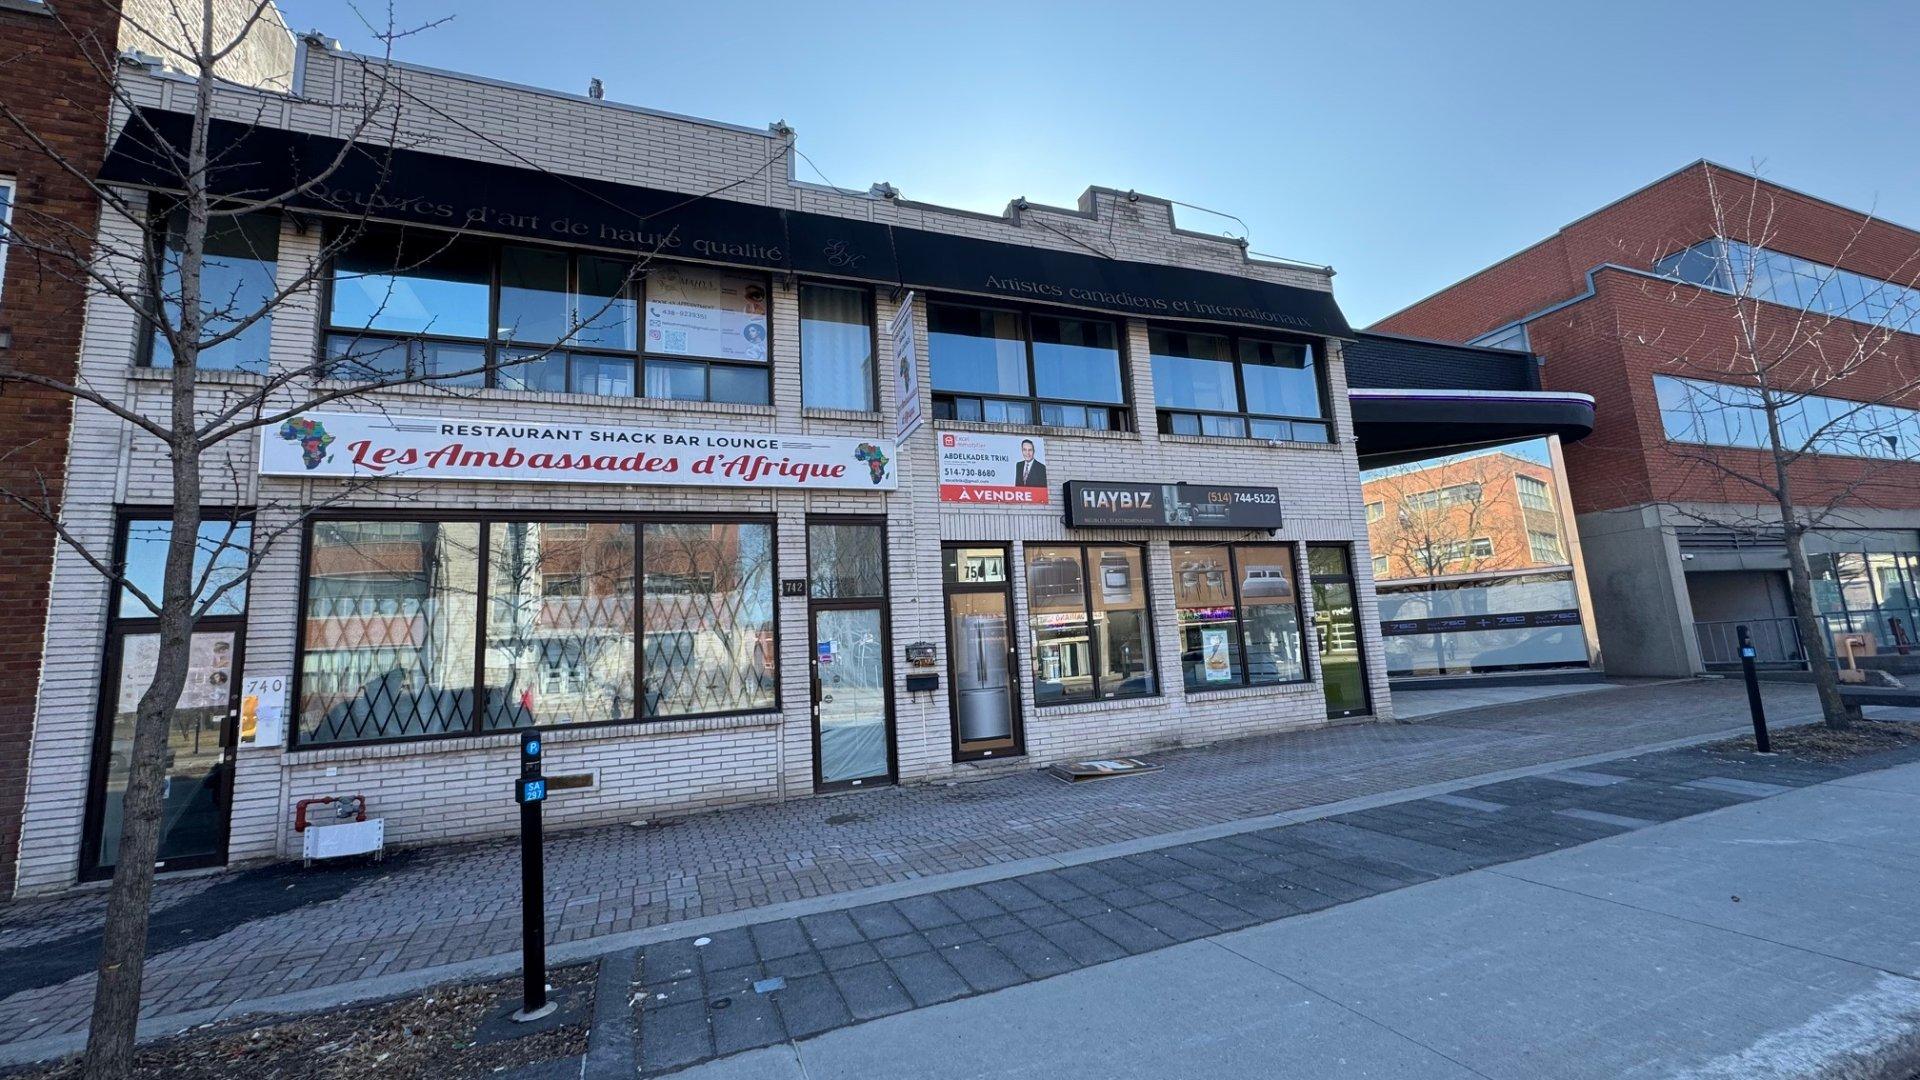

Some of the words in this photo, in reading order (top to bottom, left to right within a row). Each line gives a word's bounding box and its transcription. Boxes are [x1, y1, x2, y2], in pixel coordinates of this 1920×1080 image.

[465, 205, 540, 230] d'art
[550, 217, 590, 236] de
[693, 238, 784, 262] qualité
[984, 275, 1063, 297] Artistes
[1069, 287, 1167, 311] canadiens
[1172, 300, 1191, 313] et
[1194, 300, 1312, 328] internationaux
[441, 424, 583, 441] RESTAURANT
[589, 431, 657, 445] SHACK
[663, 434, 700, 446] BAR
[707, 436, 779, 450] LOUNGE
[347, 440, 418, 472] Les
[424, 443, 679, 473] Ambassades
[691, 453, 846, 482] d'Afrique
[944, 452, 989, 462] ABDELKADER
[991, 455, 1009, 463] TRIKI
[944, 467, 996, 478] 514-730-8680
[959, 487, 971, 500] À
[974, 490, 1033, 502] VENDRE
[1083, 490, 1153, 513] HAYBIZ
[1207, 491, 1232, 505] (514)
[1234, 492, 1276, 505] 744-5122
[786, 582, 803, 593] 742
[247, 679, 282, 693] 740
[528, 781, 540, 791] SA
[527, 790, 542, 800] 297
